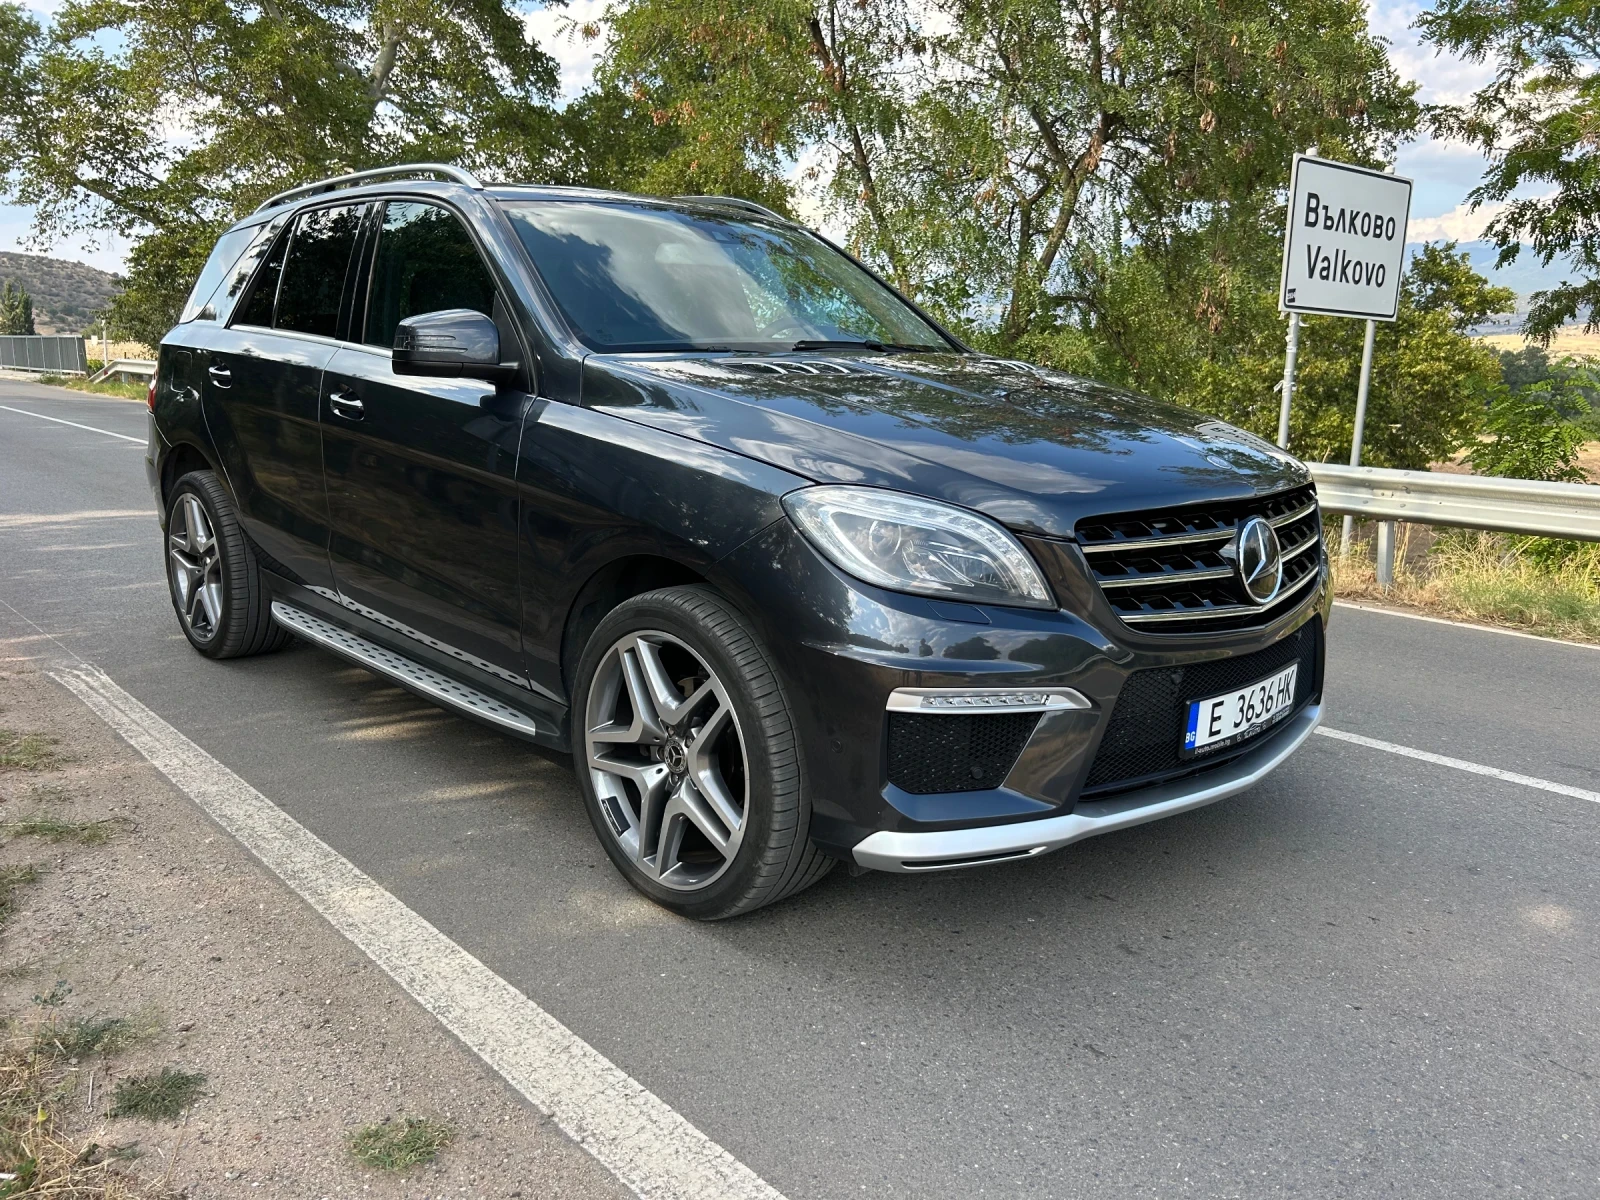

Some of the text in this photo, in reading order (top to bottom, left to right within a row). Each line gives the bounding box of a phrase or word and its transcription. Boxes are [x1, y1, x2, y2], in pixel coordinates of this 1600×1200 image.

[1304, 192, 1396, 241] Вълково
[1306, 244, 1386, 288] Valkovo
[1208, 700, 1225, 738] E
[1233, 680, 1275, 729] 3636
[1275, 669, 1295, 709] HK
[1185, 731, 1196, 743] BG
